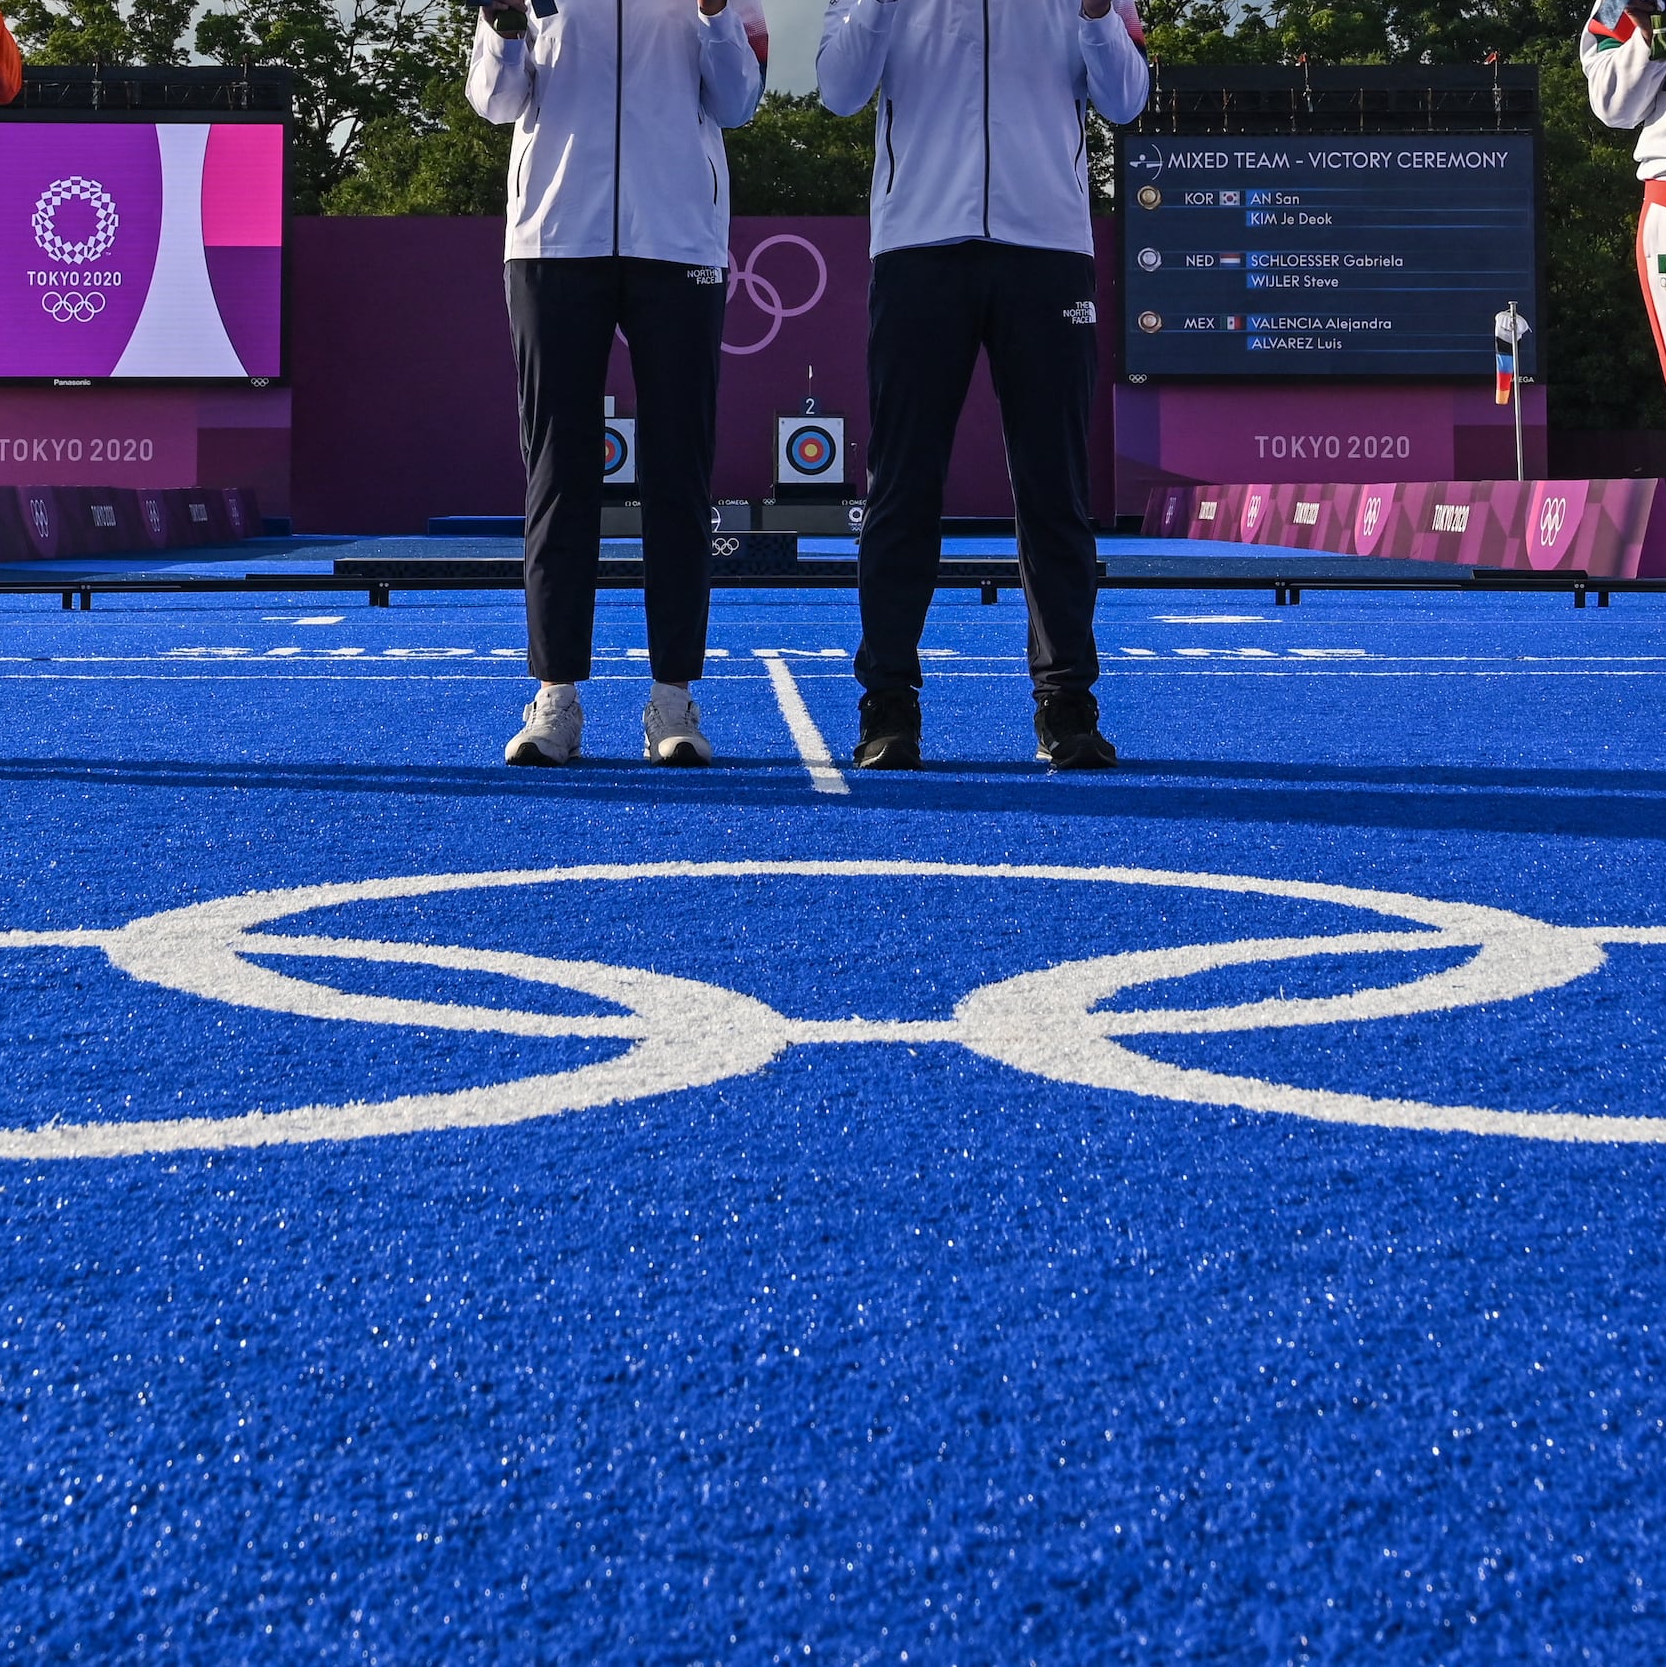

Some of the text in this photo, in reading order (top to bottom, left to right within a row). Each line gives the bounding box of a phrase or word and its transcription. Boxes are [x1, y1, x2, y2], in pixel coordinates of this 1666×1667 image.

[1168, 152, 1228, 169] MIXED
[1233, 152, 1290, 169] TEAM
[1308, 152, 1392, 169] VICTORY
[1397, 151, 1508, 169] CEREMONY
[1184, 192, 1300, 206] KOR AN San
[1250, 212, 1333, 226] KIM Je Deok
[1185, 253, 1404, 268] NED SCHLOESSER Gabriela
[27, 271, 122, 286] TOKYO 2020
[686, 269, 715, 278] NORTH
[696, 276, 715, 285] FACE
[1251, 275, 1339, 288] WIJLER Steve
[1063, 309, 1088, 317] NORTH
[1072, 316, 1089, 324] FACE
[1184, 316, 1392, 333] MEX VALENCIA Alejandra
[1251, 337, 1342, 350] ALVAREZ Luis
[53, 378, 92, 386] Panasonic
[806, 398, 815, 415] 2
[89, 438, 154, 462] 2020
[1255, 435, 1411, 459] TOKYO 2020
[1432, 504, 1470, 532] TOKYO 2020
